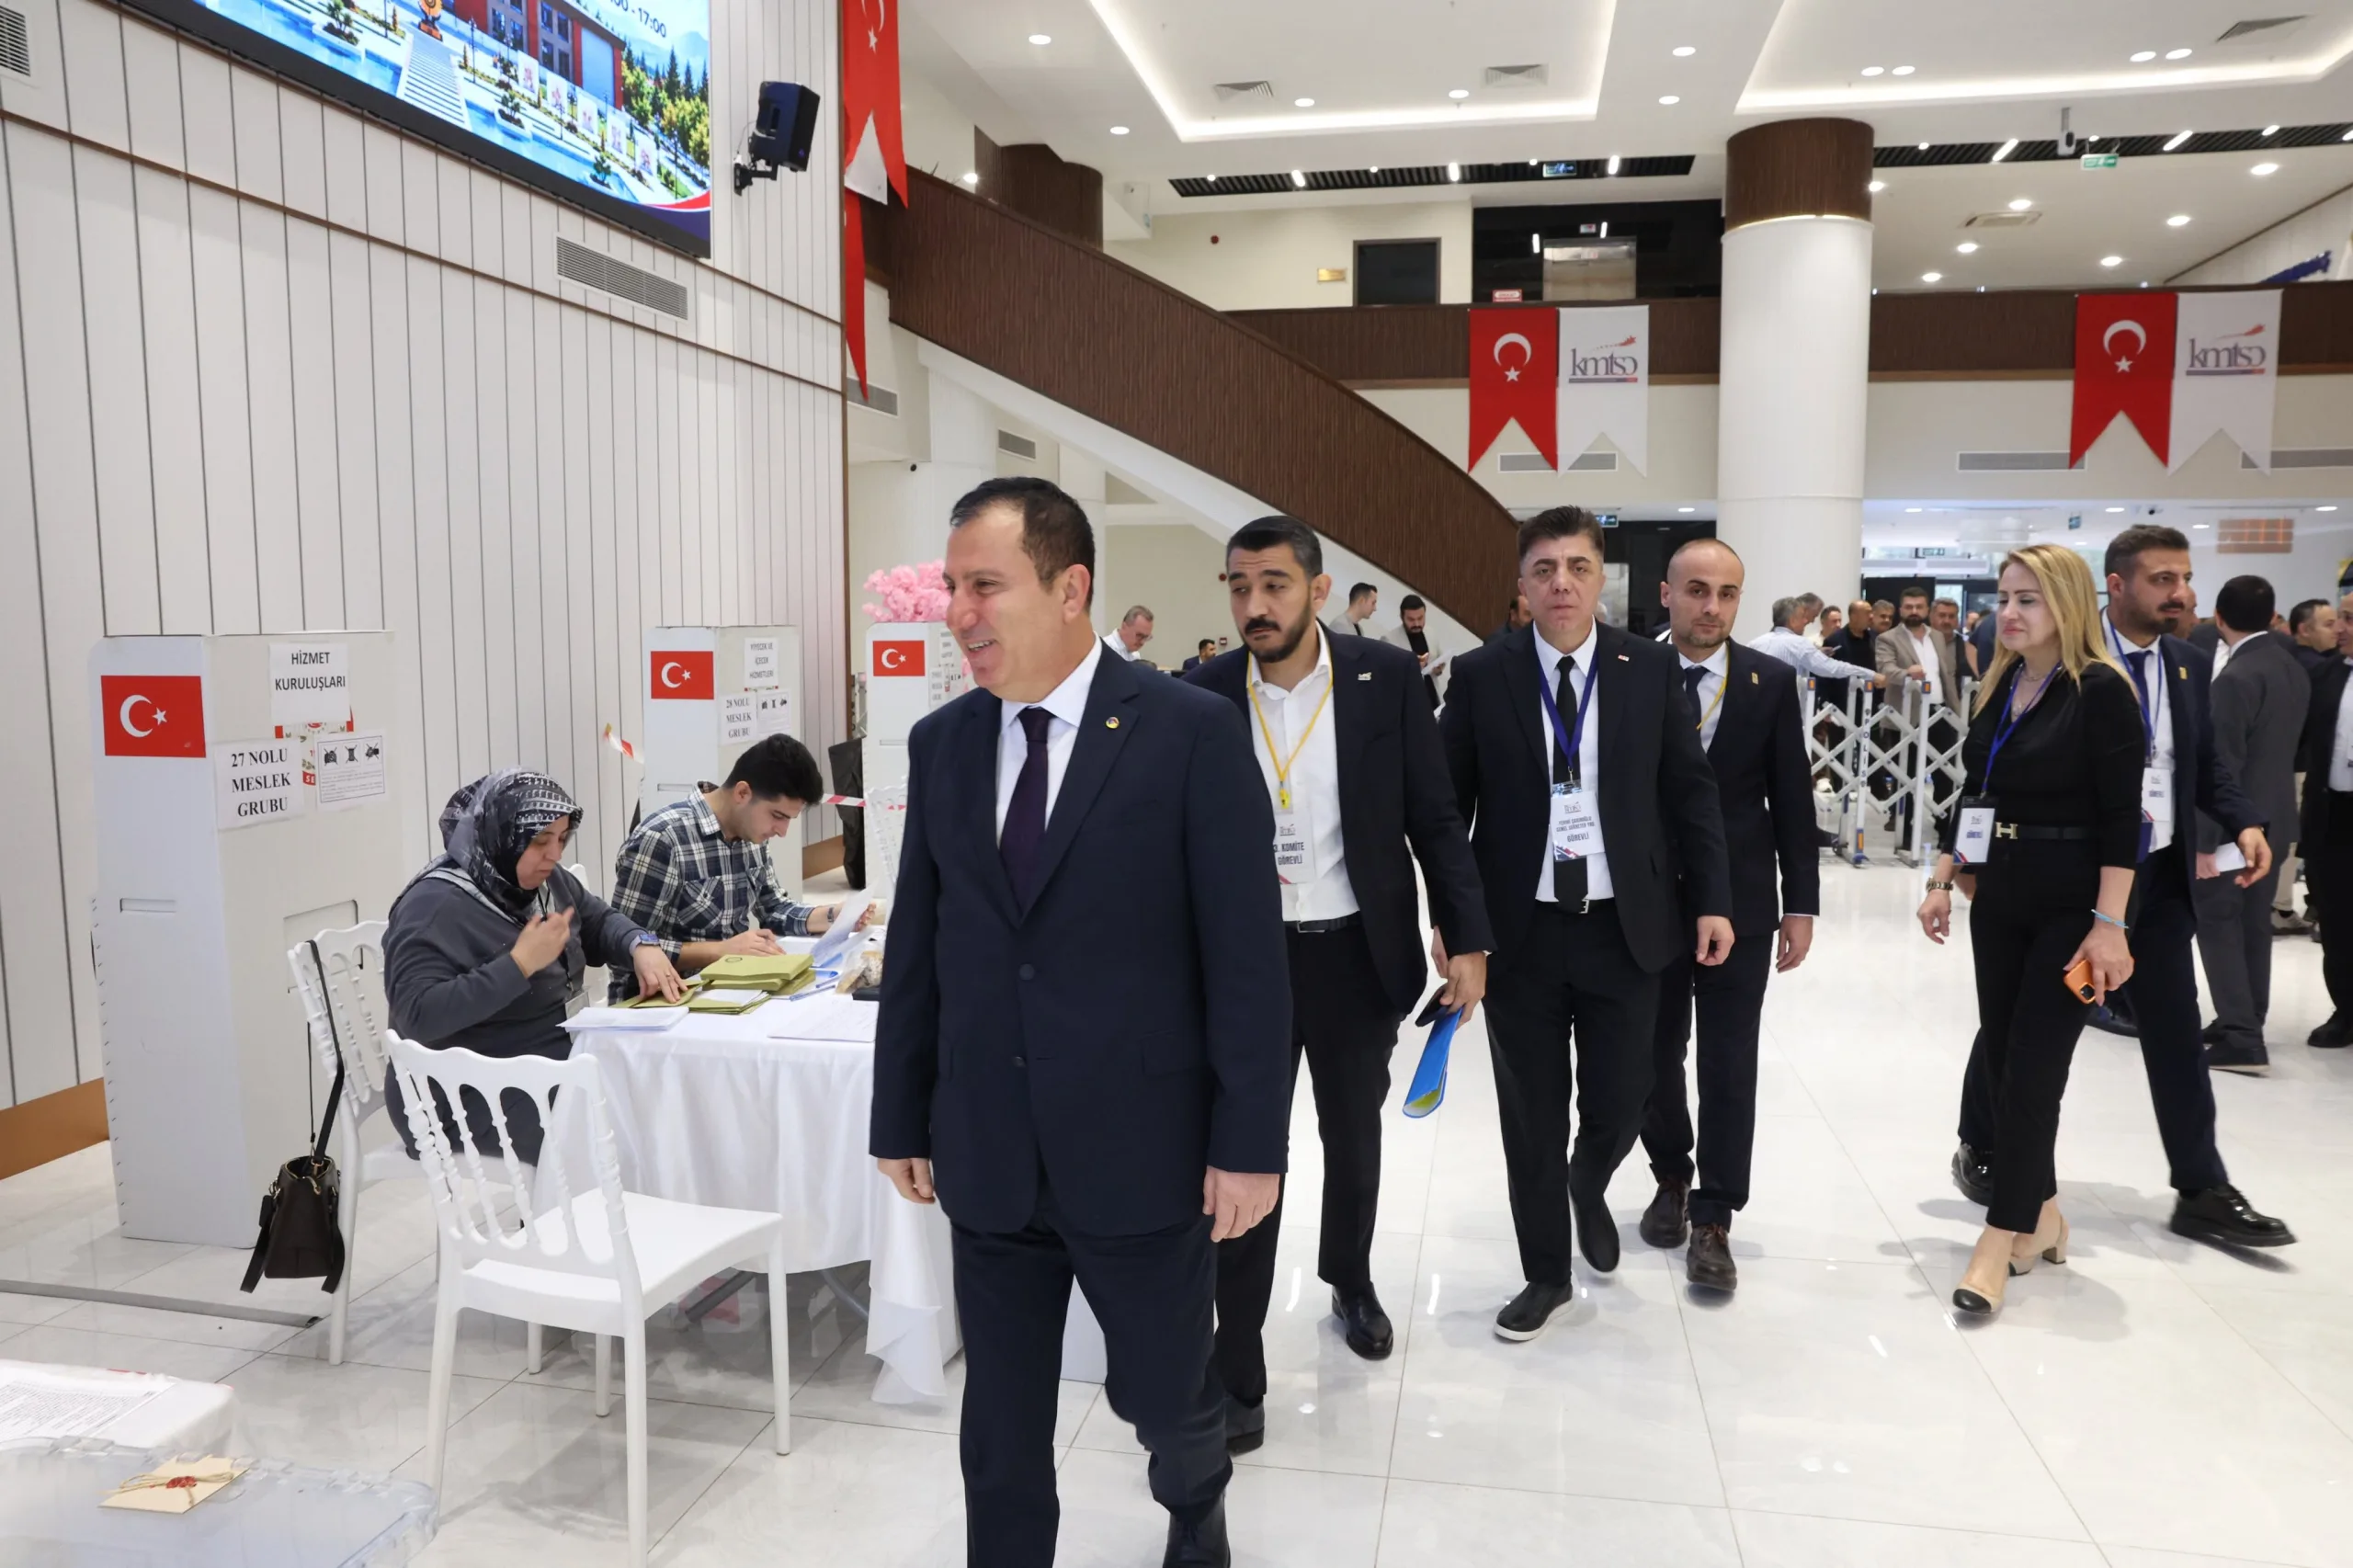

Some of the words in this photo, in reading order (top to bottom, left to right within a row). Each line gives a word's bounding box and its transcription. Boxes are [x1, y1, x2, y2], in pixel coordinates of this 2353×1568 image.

[638, 7, 666, 38] 17:00
[290, 649, 331, 665] HİZMET
[275, 676, 346, 691] KURULUŞLARI
[725, 699, 733, 709] 28
[733, 698, 749, 707] NOLU
[726, 712, 752, 723] MESLEK
[728, 727, 750, 738] GRUBU
[231, 753, 244, 767] 27
[248, 748, 289, 767] NOLU
[232, 772, 291, 793] MESLEK
[237, 797, 289, 817] GRUBU
[1567, 832, 1589, 842] GÖREVLİ
[1281, 841, 1305, 852] KOMİTE
[1278, 855, 1302, 865] GÖREVLİ
